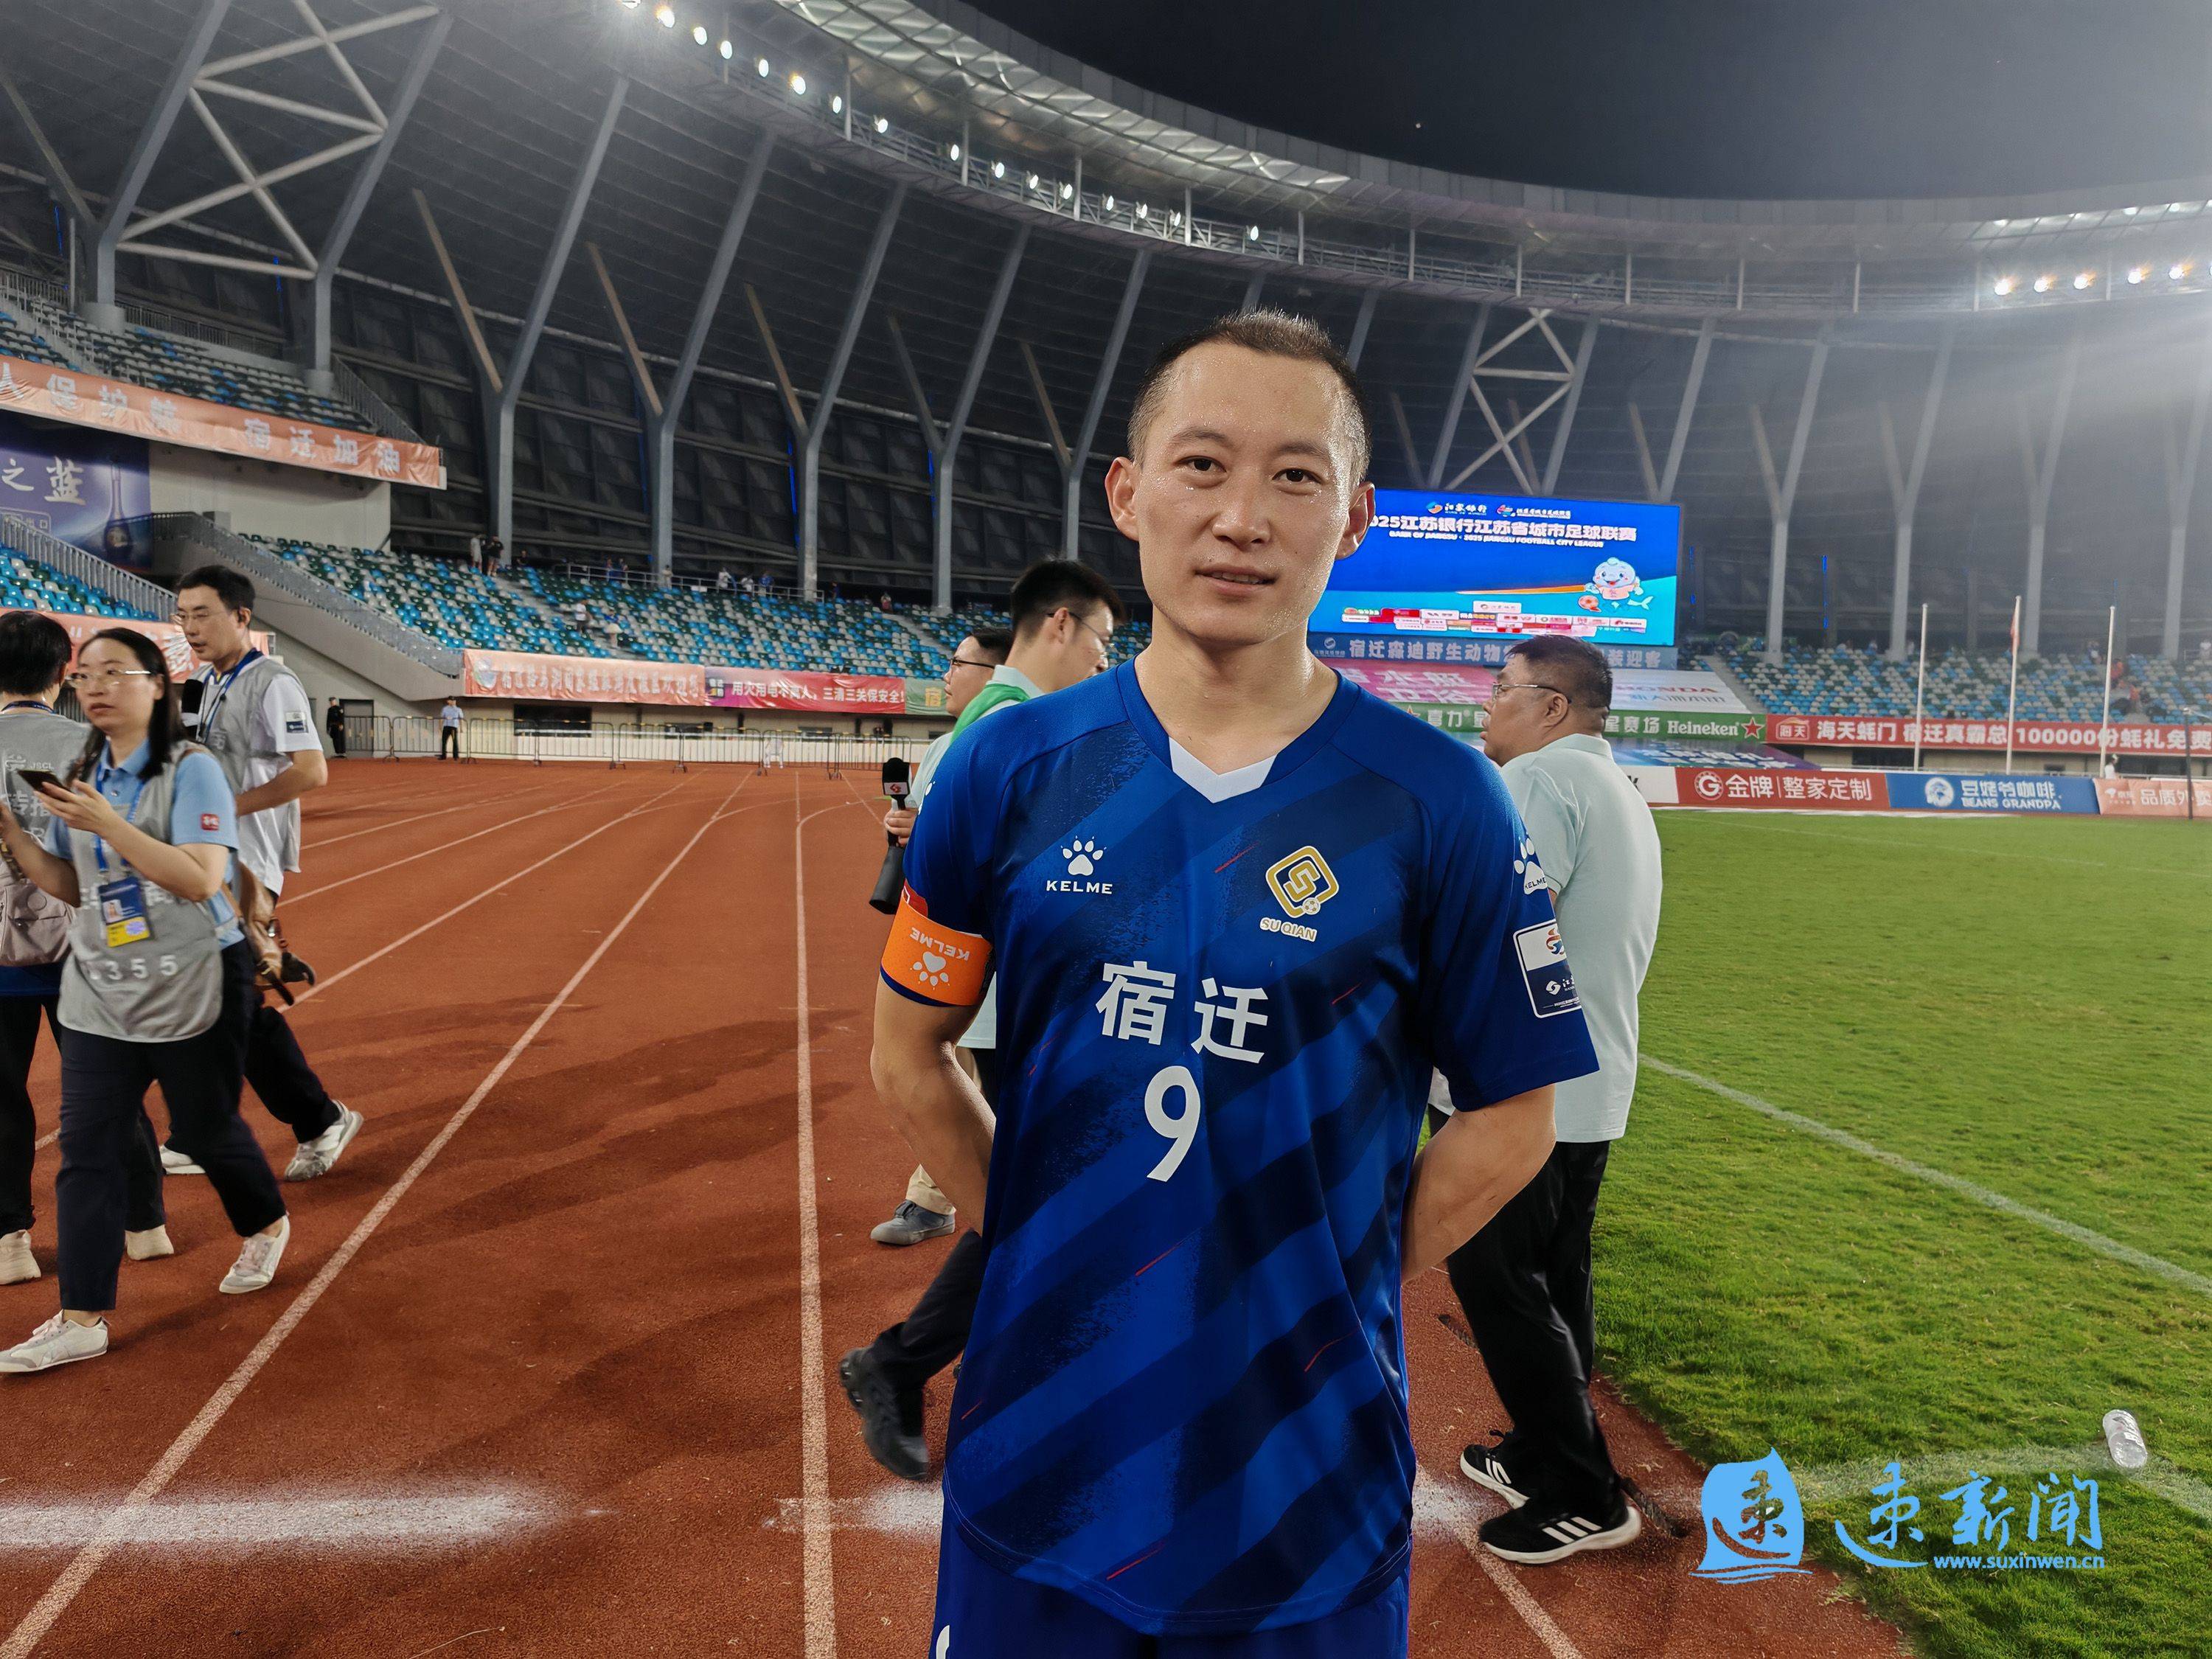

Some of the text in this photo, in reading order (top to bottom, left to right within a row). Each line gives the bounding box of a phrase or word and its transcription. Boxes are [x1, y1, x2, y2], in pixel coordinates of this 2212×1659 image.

[244, 418, 400, 473] 宿迁加油
[2, 456, 87, 506] 之蓝
[1369, 515, 1637, 542] 025江苏银行江苏省城市足球联赛
[1667, 720, 1738, 737] Heineken
[1725, 774, 1871, 801] 金牌 整家定制
[2002, 799, 2061, 810] GRANDPA
[1046, 880, 1113, 895] KELME
[909, 927, 970, 961] KELME
[1259, 917, 1318, 944] SU QIAN
[1095, 961, 1268, 1064] 宿迁
[1144, 1065, 1200, 1182] 9
